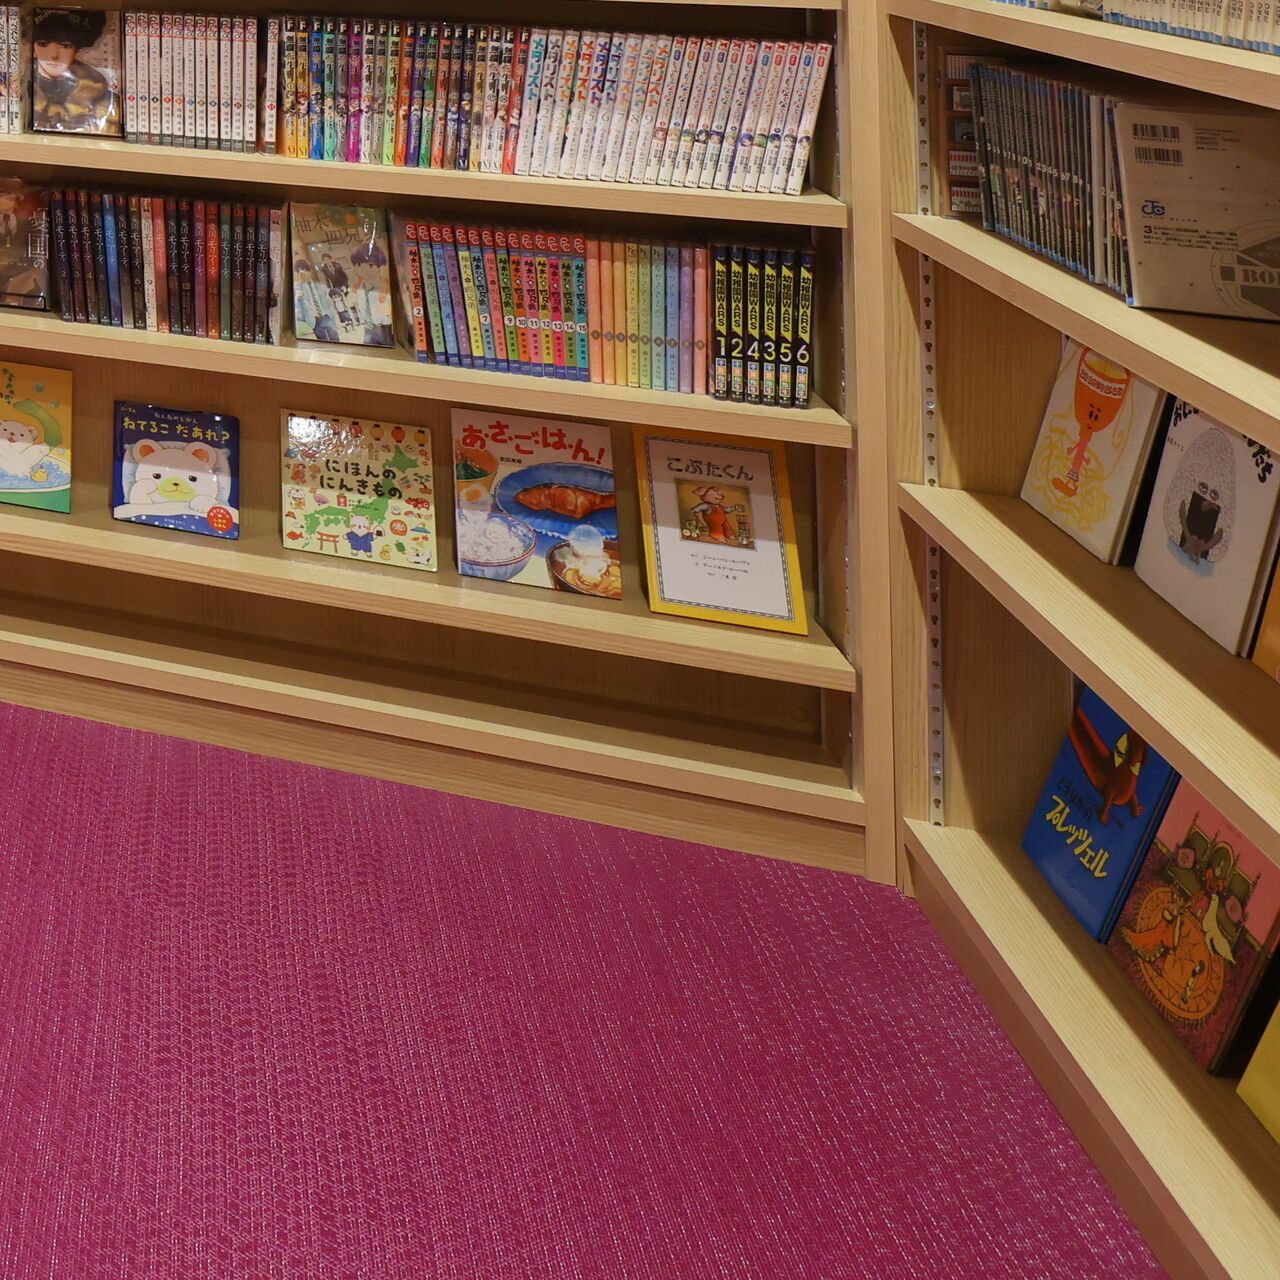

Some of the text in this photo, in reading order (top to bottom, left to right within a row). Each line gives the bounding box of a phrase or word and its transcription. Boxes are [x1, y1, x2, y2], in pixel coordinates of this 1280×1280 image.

[28, 208, 49, 269] 憂国の
[717, 337, 726, 356] 1
[747, 341, 759, 360] 4
[780, 343, 792, 362] 5
[123, 417, 230, 444] ねてるこ だあれ?
[325, 459, 397, 479] にほんの
[667, 457, 754, 482] こぶたくん
[320, 475, 403, 499] にんきもの
[1044, 795, 1109, 879] プレッツェル
